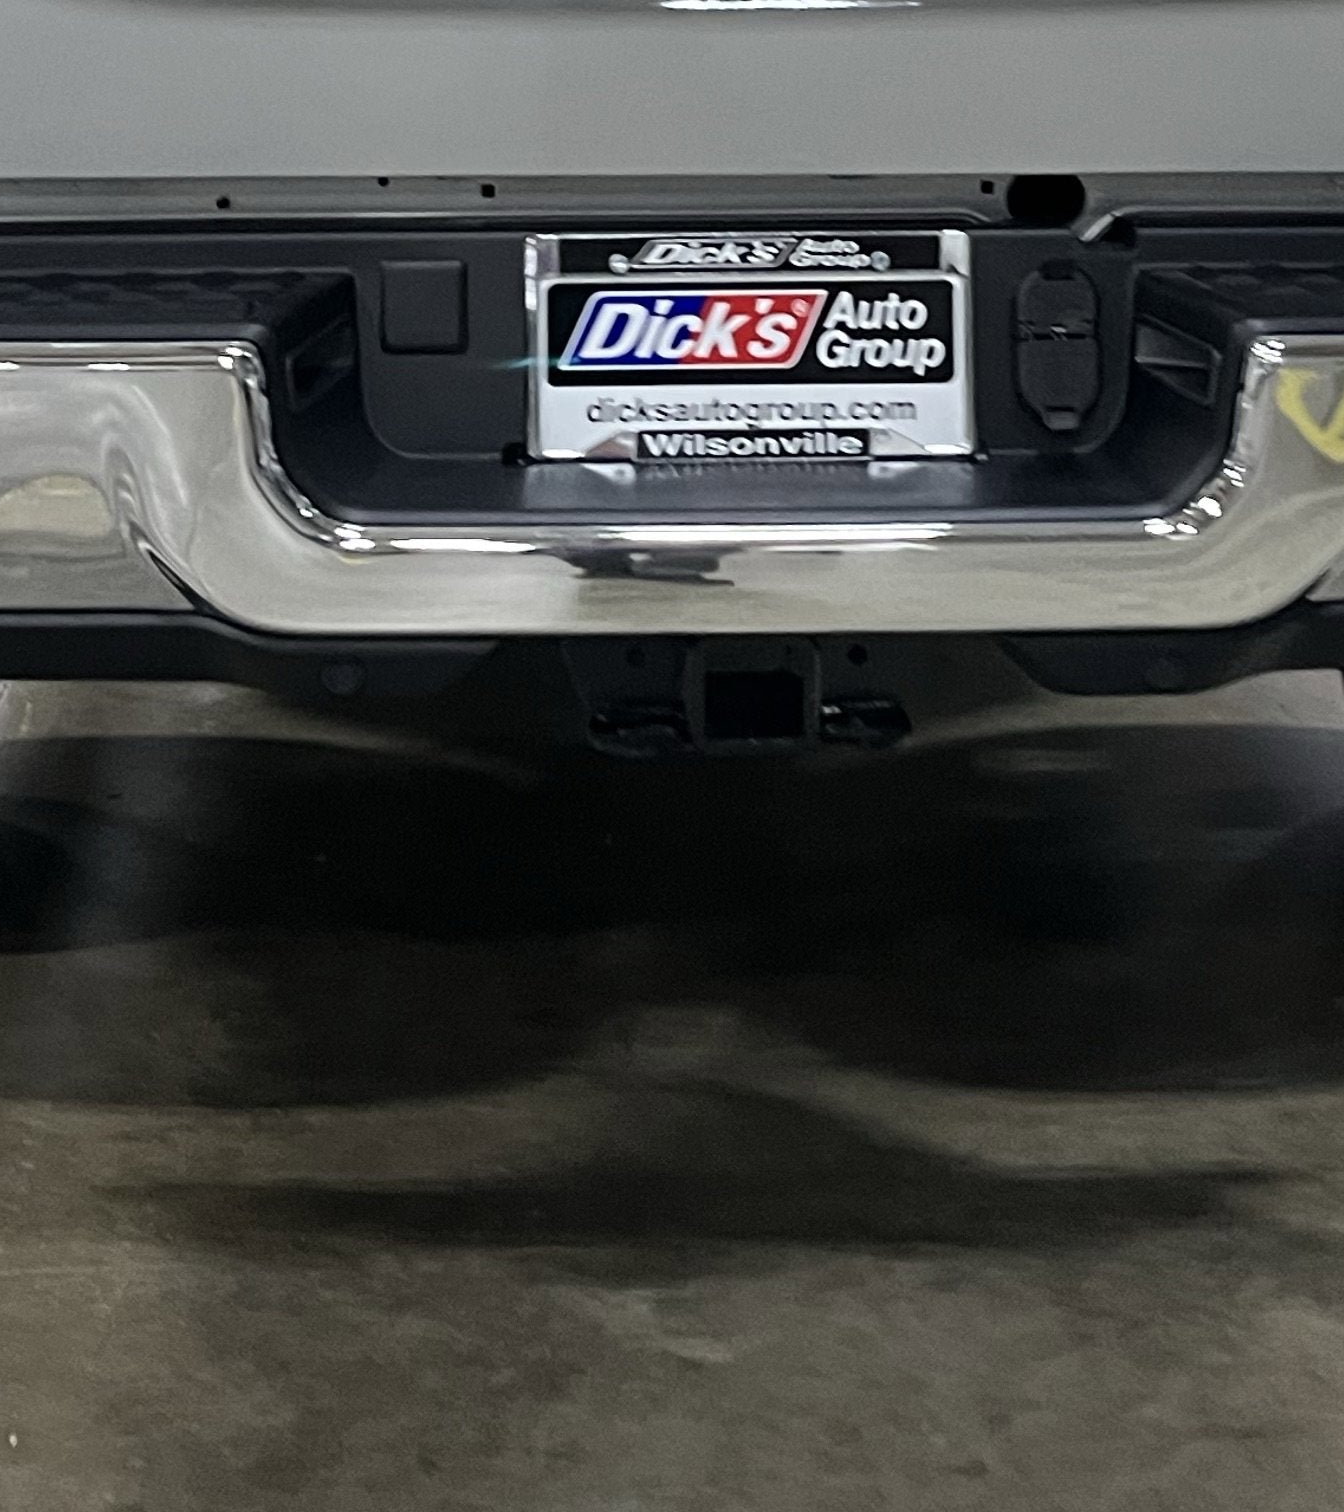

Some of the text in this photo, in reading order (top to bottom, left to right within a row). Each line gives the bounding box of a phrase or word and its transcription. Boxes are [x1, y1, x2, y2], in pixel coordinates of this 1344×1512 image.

[641, 240, 781, 265] Dick's
[799, 238, 859, 254] Auto
[822, 291, 929, 331] Auto
[578, 298, 798, 360] Dick's
[815, 329, 946, 377] Group
[586, 396, 918, 430] dicksautogroup.com
[641, 430, 865, 457] Wilsonville
